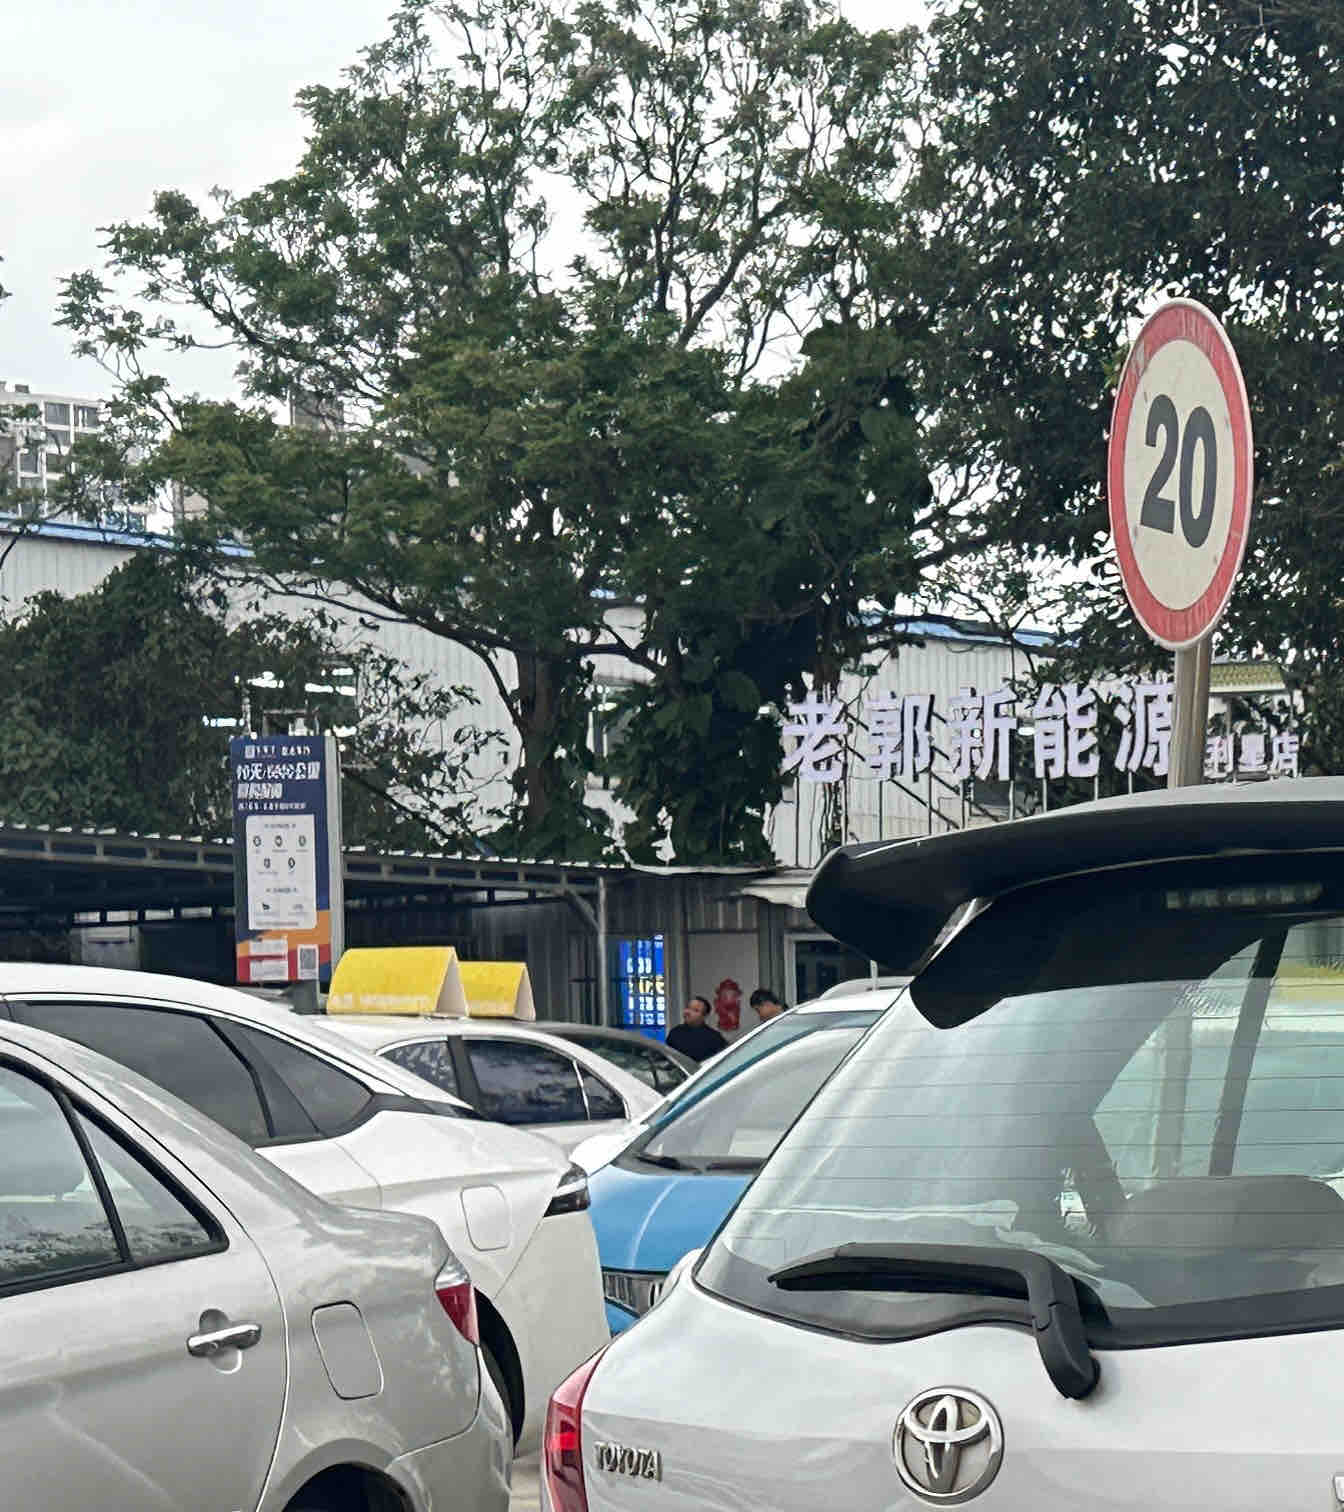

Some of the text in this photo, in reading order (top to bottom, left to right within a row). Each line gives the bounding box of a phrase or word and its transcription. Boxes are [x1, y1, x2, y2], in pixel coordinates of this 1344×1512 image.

[1140, 393, 1218, 549] 20
[780, 682, 1175, 783] 老郭新能源
[592, 1439, 663, 1482] TOYOTA
